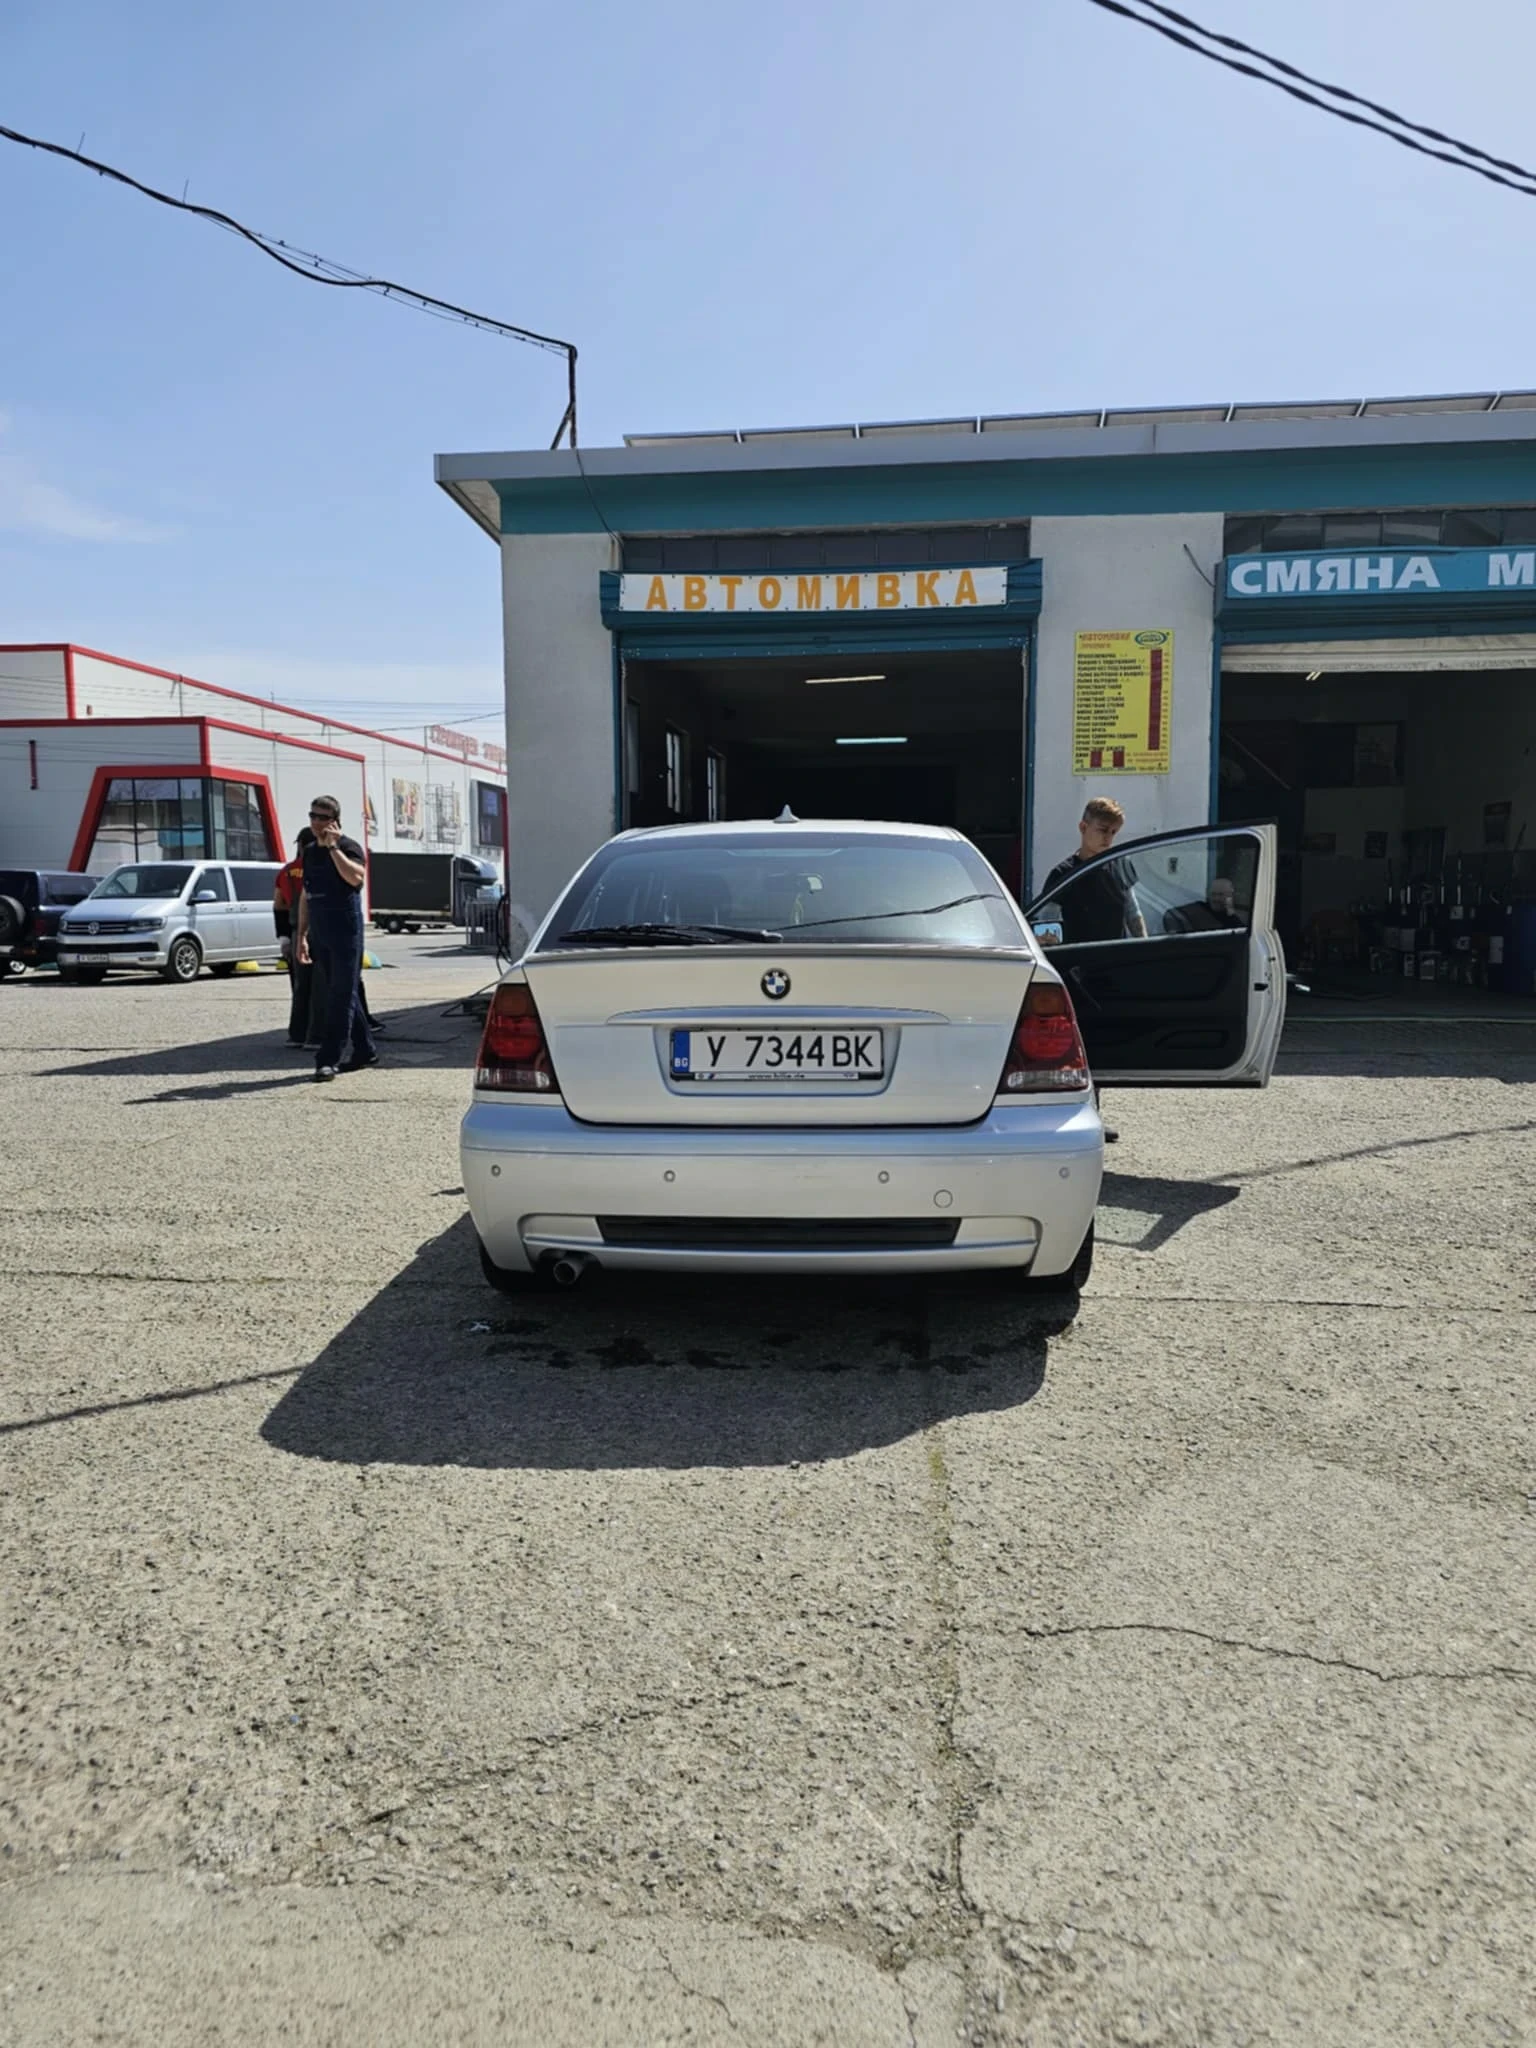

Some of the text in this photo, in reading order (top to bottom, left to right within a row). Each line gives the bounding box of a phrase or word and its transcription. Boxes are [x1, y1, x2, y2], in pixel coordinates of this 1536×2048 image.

[646, 570, 978, 610] АВТОМИВКА
[1231, 556, 1440, 594] СМЯНА
[674, 1057, 688, 1067] BG
